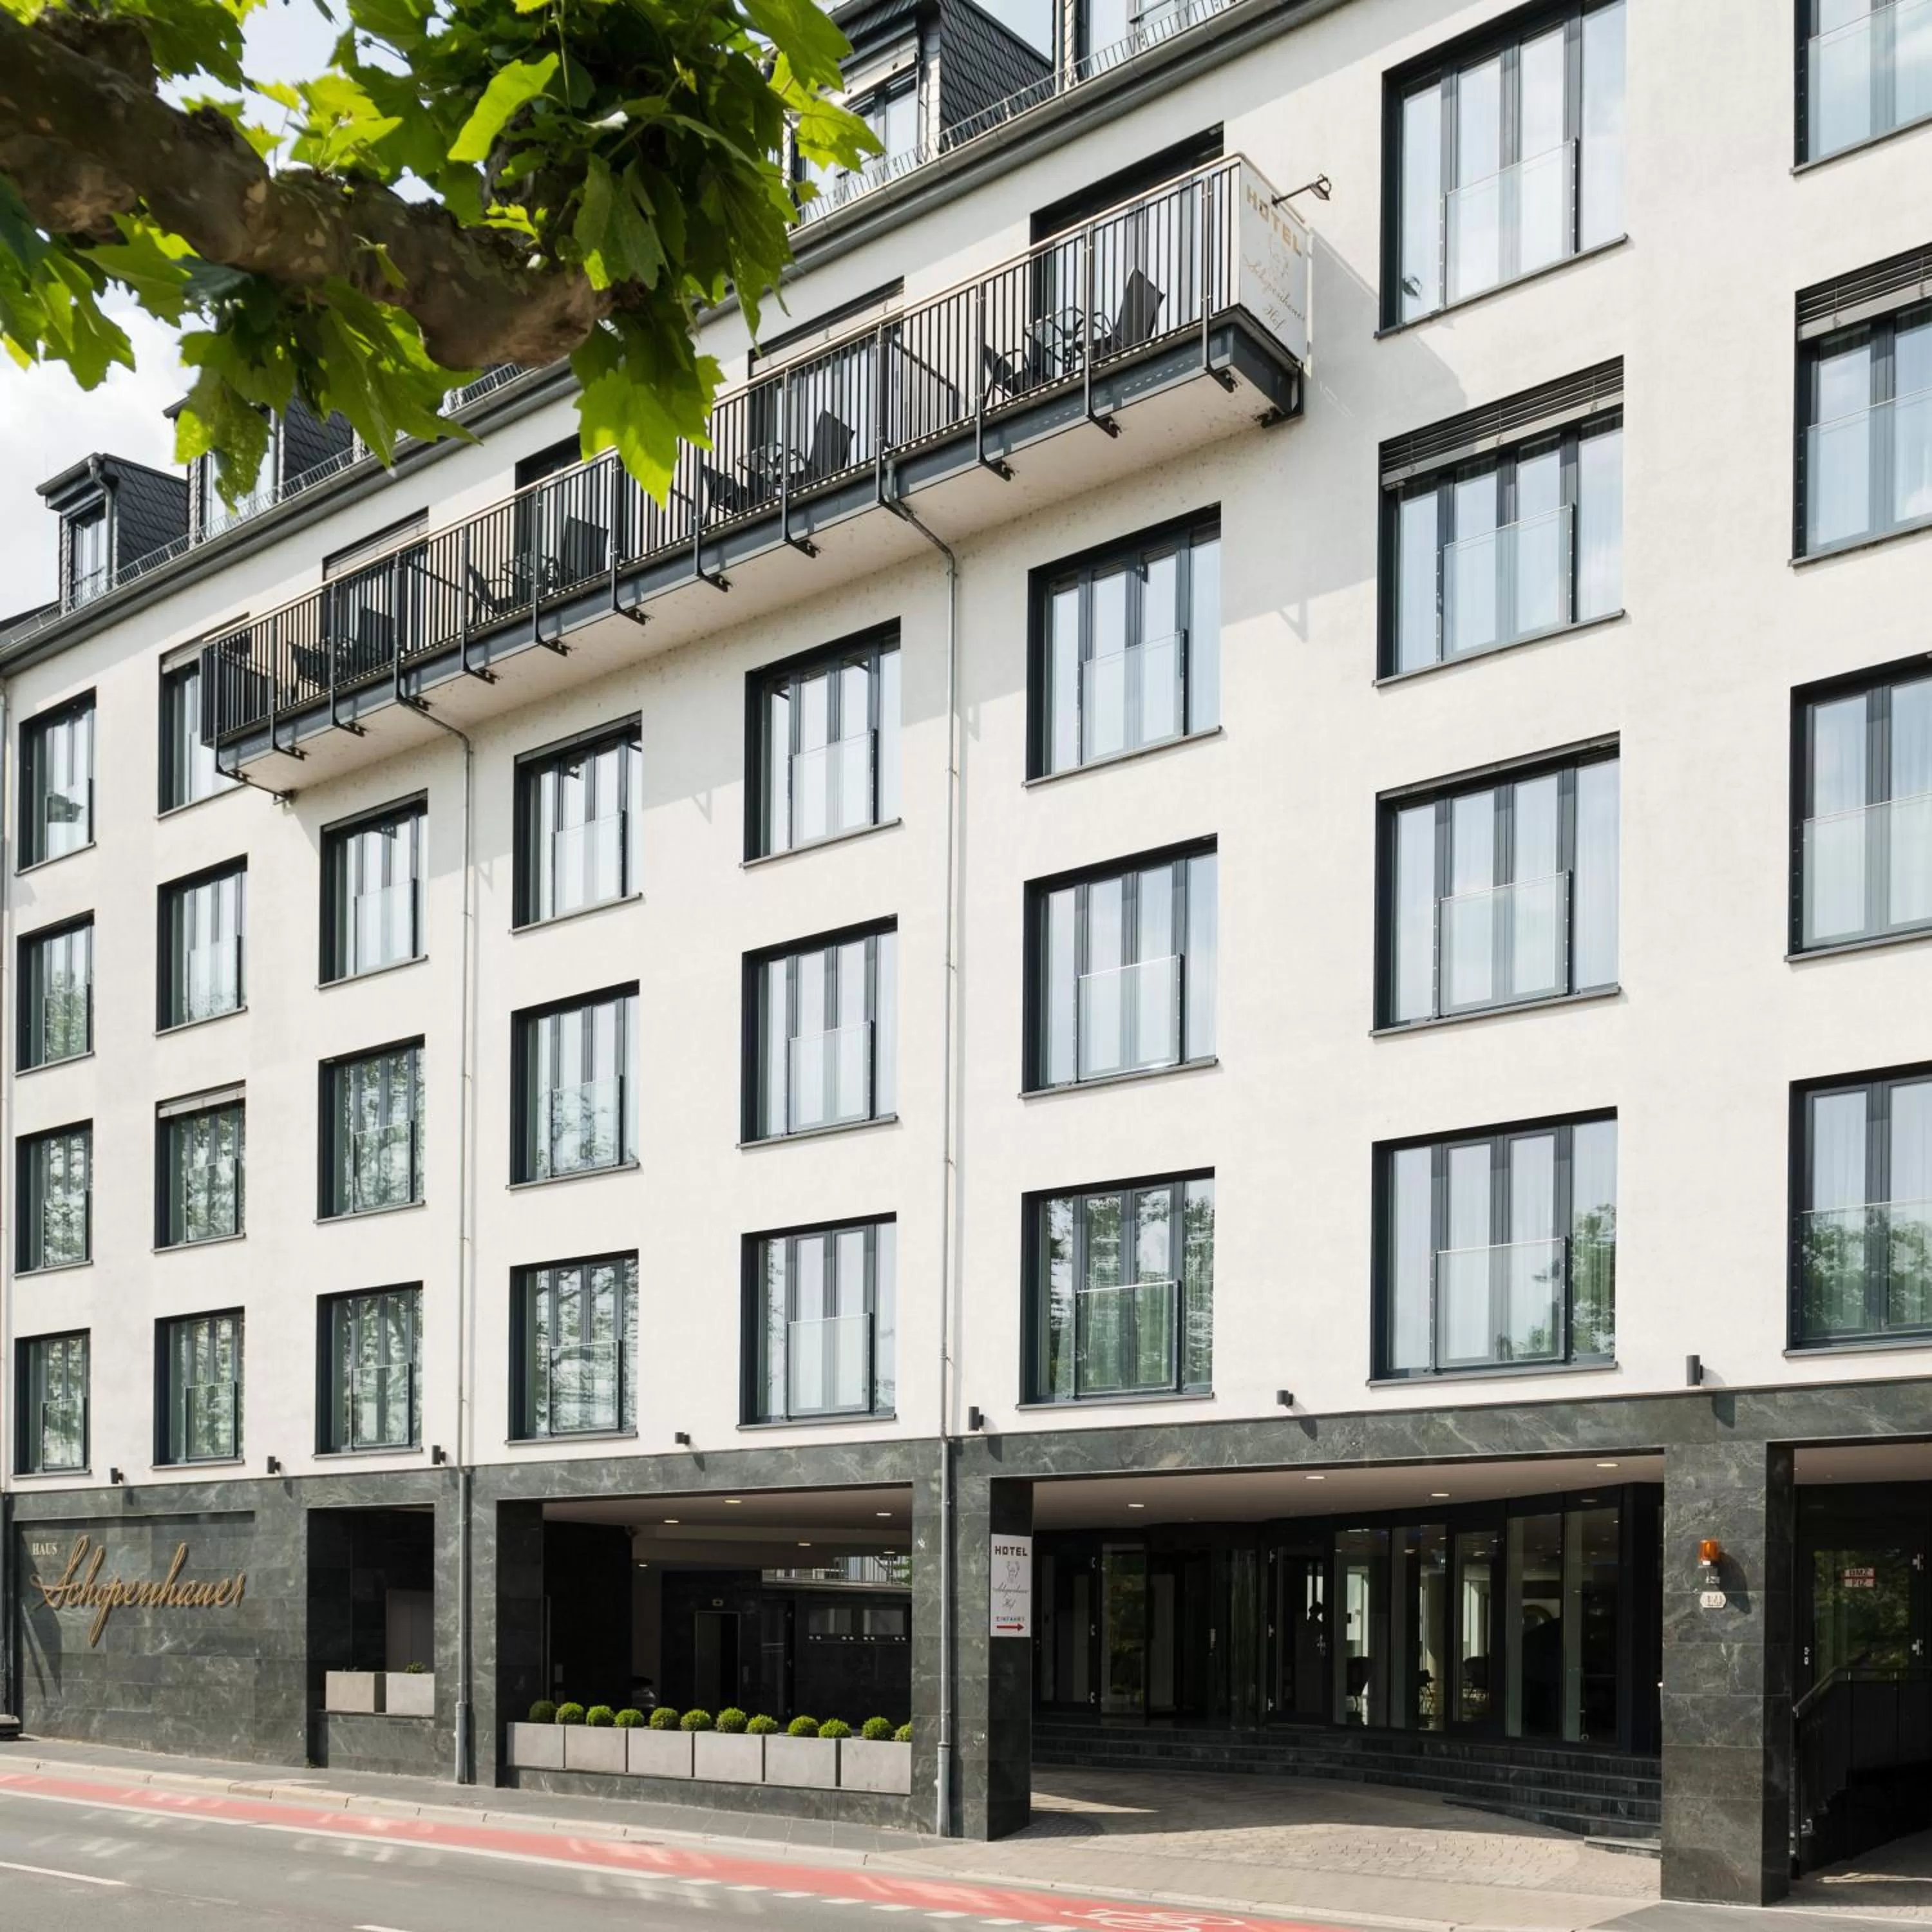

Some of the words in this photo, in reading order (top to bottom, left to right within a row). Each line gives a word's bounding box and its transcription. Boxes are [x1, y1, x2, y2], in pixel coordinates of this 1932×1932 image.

[1246, 184, 1302, 257] HOTEL
[31, 1542, 57, 1555] HAUS
[994, 1545, 1028, 1557] HOTEL
[30, 1535, 246, 1648] Schopenhauer
